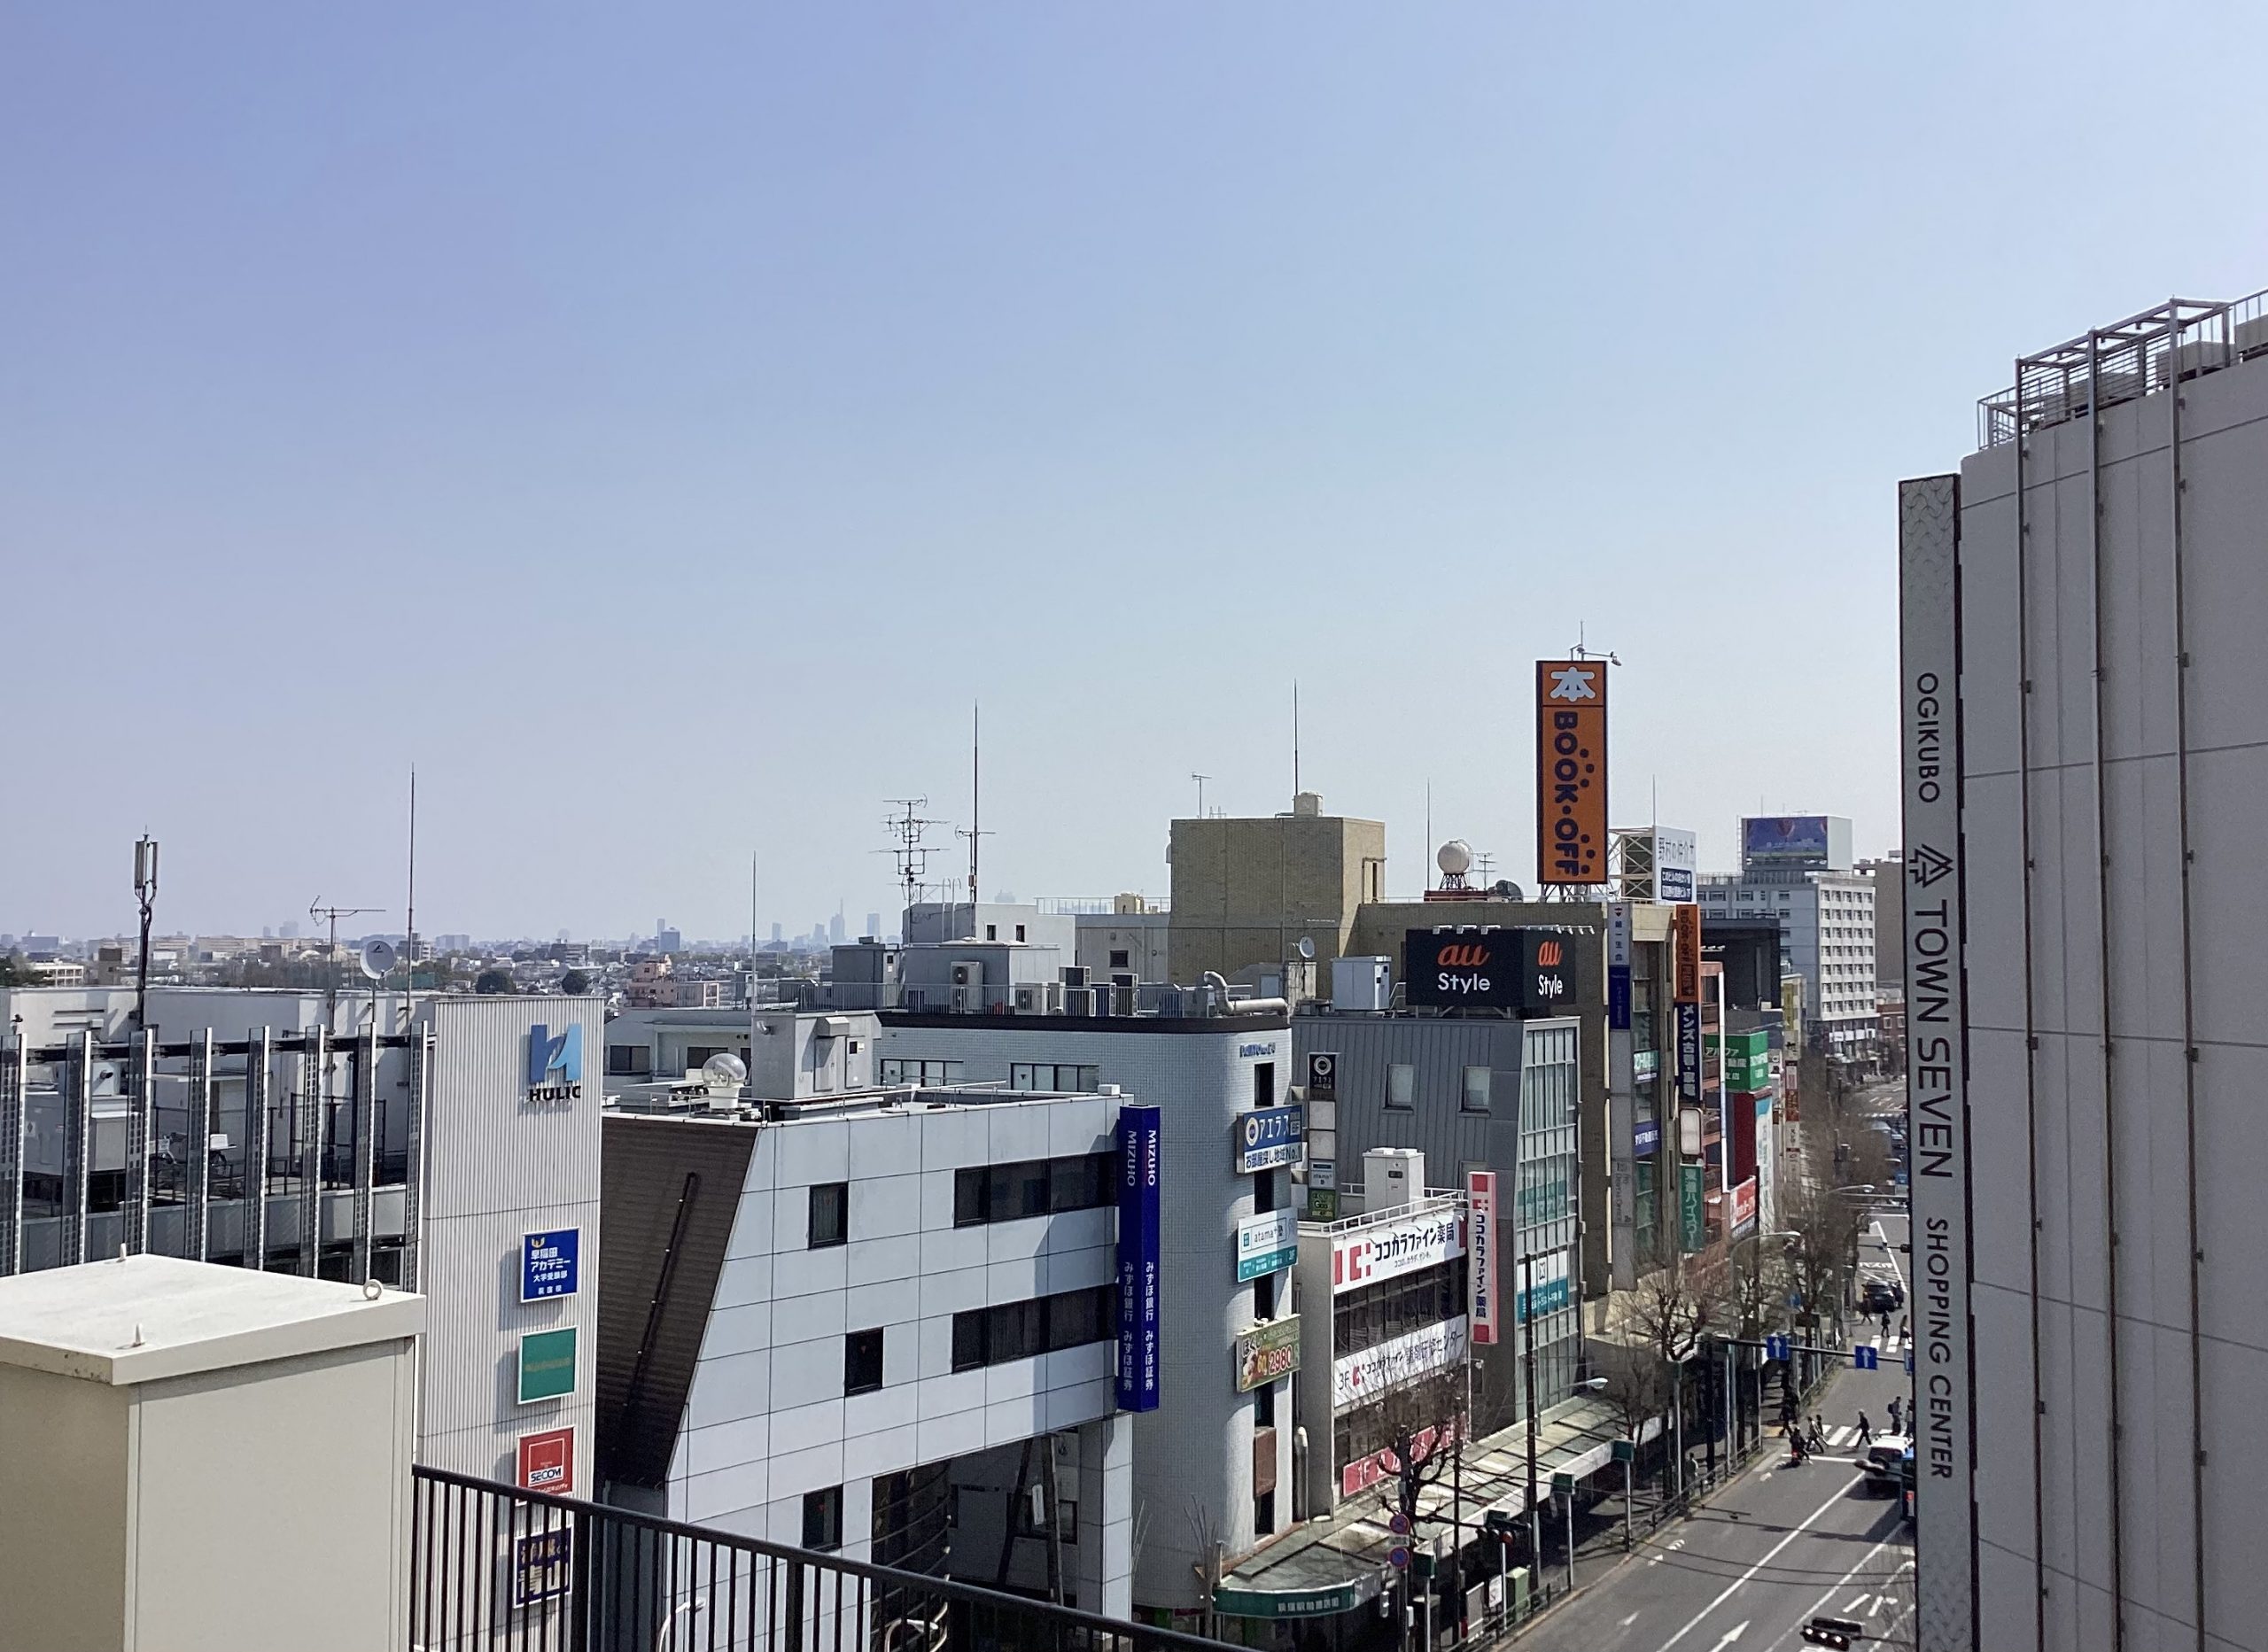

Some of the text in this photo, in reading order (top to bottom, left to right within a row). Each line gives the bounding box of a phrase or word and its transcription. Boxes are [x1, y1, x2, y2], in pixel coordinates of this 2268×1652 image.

[1550, 666, 1596, 702] 本
[1917, 672, 1939, 803] OGIKUBO
[1437, 944, 1490, 966] au
[1538, 941, 1563, 966] au
[1437, 972, 1491, 994] Style
[1538, 973, 1563, 998] Style
[1915, 899, 1953, 1177] TOWN SEVEN
[529, 1085, 581, 1101] HULIC
[1127, 1130, 1137, 1187] MIZUHO
[1147, 1129, 1156, 1186] MIZUHO
[531, 1258, 571, 1273] アカデミー
[1375, 1222, 1455, 1262] ココカラファイン薬局
[1124, 1261, 1134, 1322] みずほ銀行
[1146, 1261, 1154, 1322] みずほ銀行
[1123, 1330, 1133, 1391] みずほ証券
[1145, 1330, 1153, 1391] みずほ証券
[1926, 1217, 1953, 1479] SHOPPING CENTER
[531, 1467, 562, 1483] SECOM
